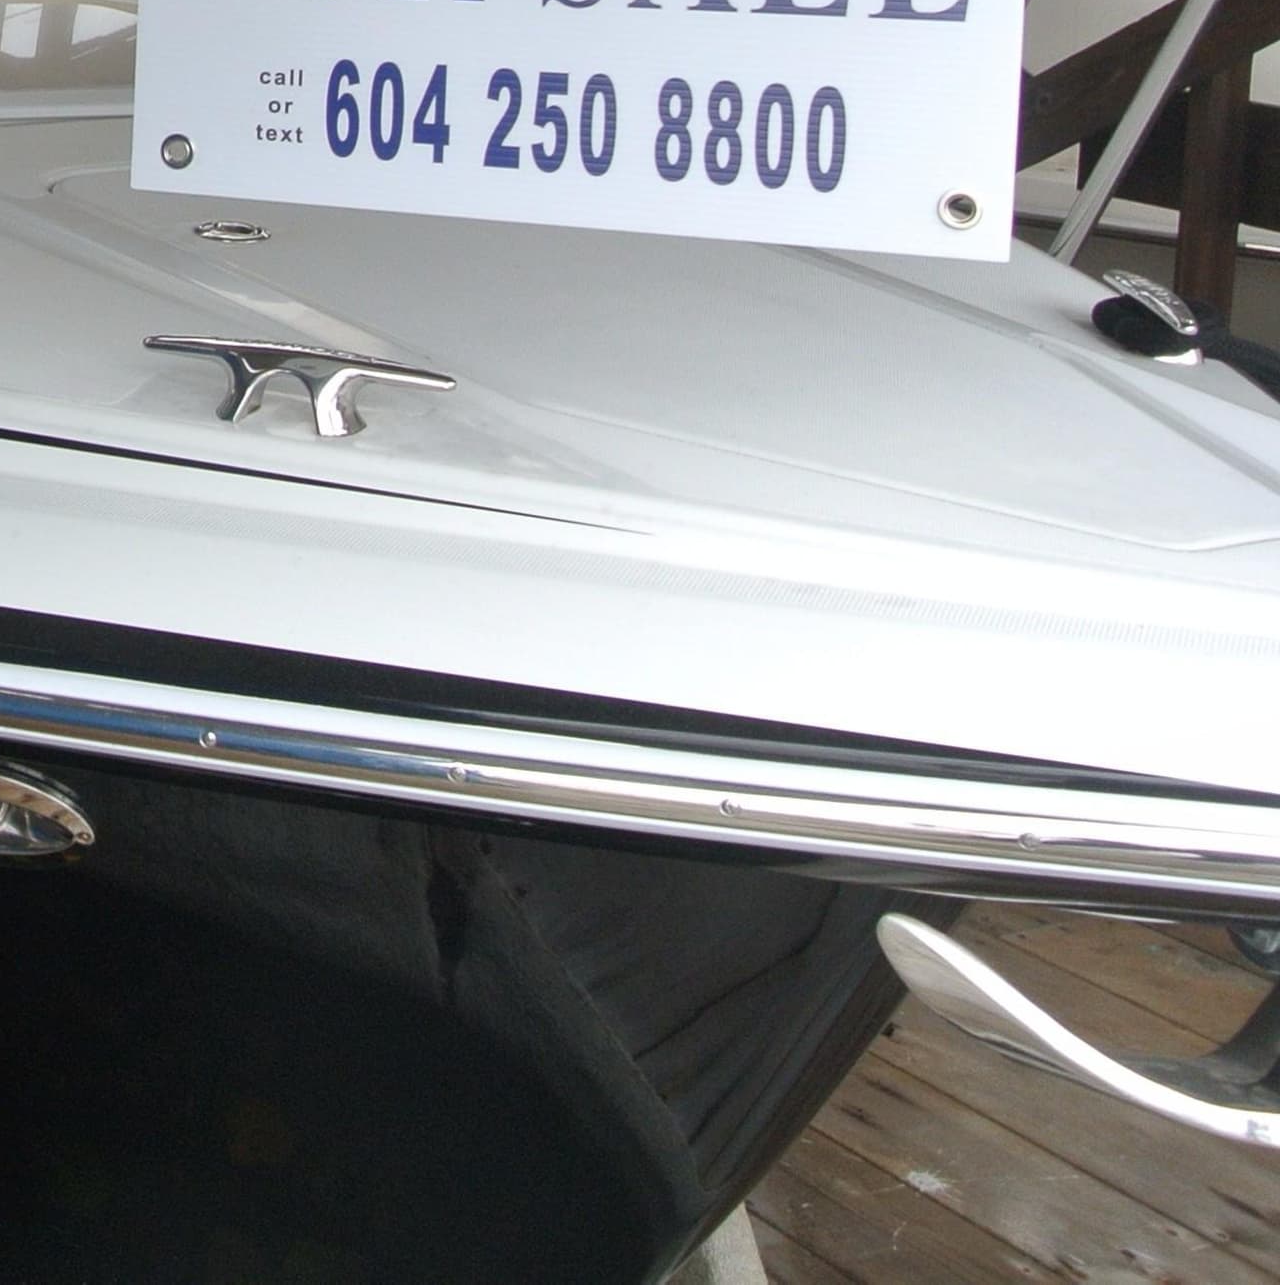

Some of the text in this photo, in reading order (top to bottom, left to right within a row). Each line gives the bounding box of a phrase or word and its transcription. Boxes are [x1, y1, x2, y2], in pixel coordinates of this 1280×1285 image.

[259, 68, 304, 88] call
[268, 98, 293, 115] or
[256, 124, 304, 144] text
[325, 58, 847, 193] 604 250 8800
